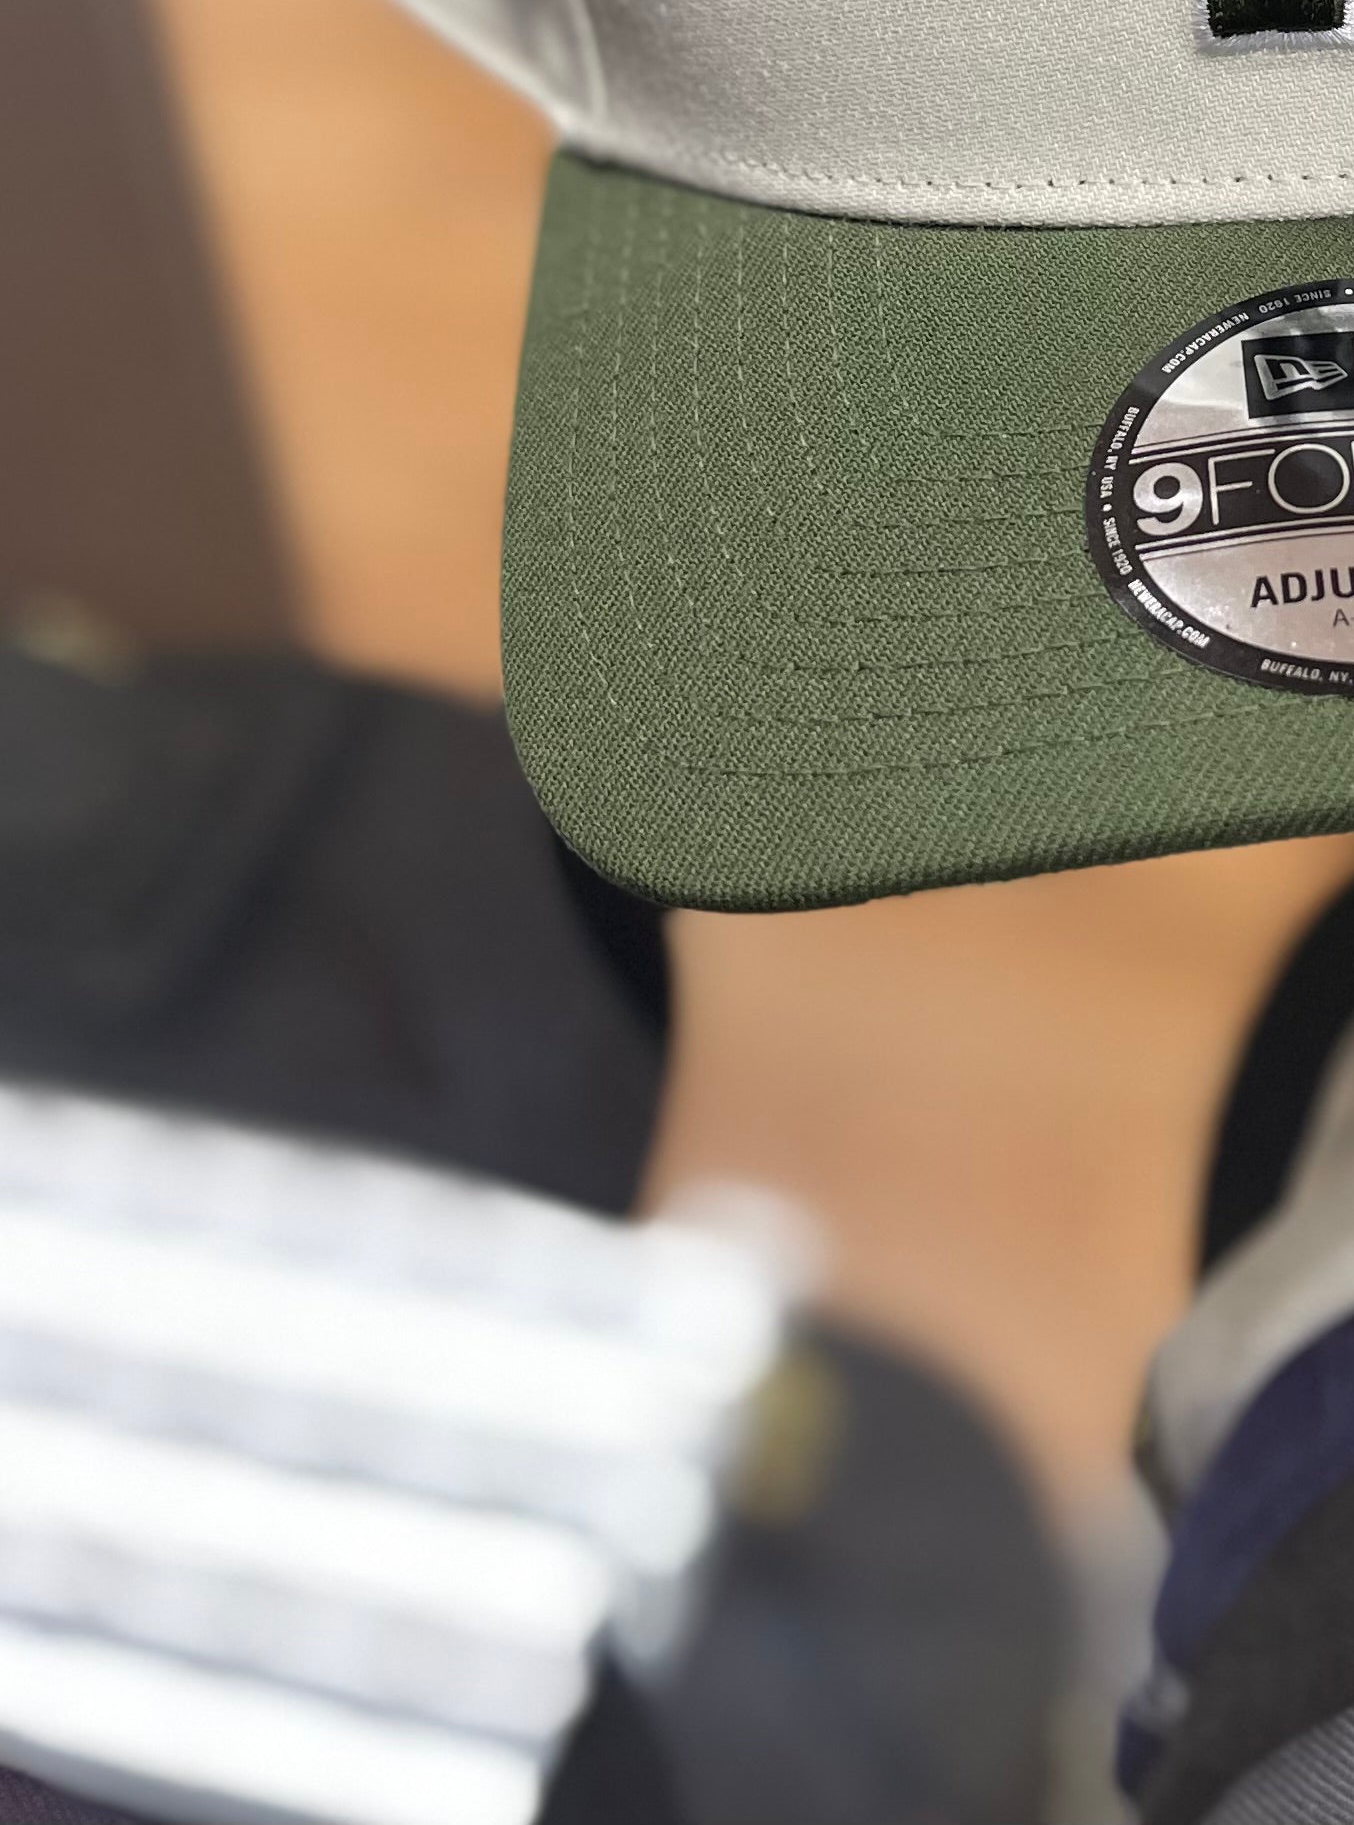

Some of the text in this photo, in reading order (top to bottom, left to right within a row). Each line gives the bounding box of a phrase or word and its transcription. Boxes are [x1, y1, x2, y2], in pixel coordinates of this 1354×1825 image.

[1258, 297, 1290, 314] 1920
[1294, 289, 1332, 303] SINCE
[1161, 311, 1250, 374] NEWERACAP.COM
[1107, 406, 1140, 453] BUFFALO,
[1100, 476, 1114, 499] USA
[1103, 517, 1121, 549] SINCE
[1111, 548, 1133, 575] 1920
[1127, 578, 1211, 649] NEWERACAP.COM
[1260, 658, 1324, 683] BUFFALO,
[1328, 670, 1353, 685] NY,
